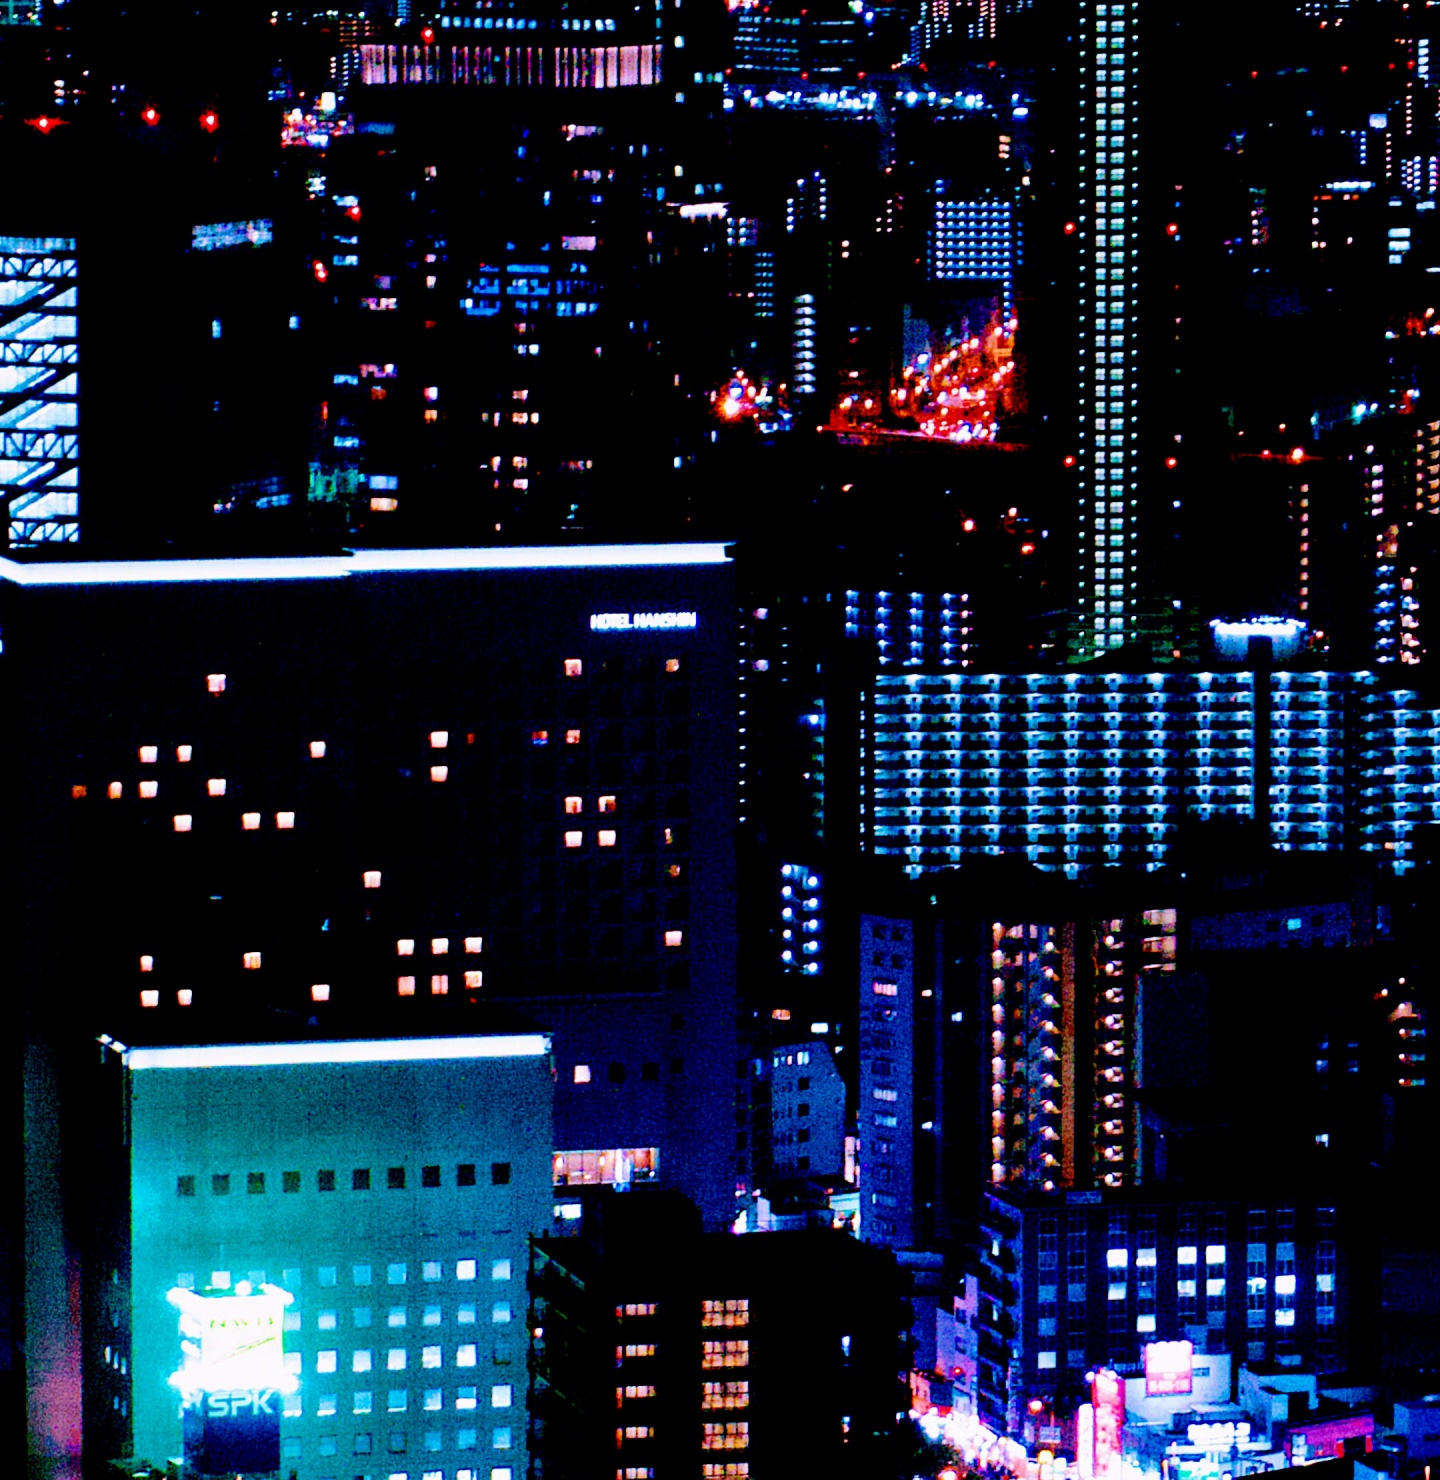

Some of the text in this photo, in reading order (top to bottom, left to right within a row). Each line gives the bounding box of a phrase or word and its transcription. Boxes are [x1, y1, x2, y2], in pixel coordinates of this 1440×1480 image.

[590, 612, 697, 629] HOTEL HANSHIN
[207, 1389, 274, 1418] SPK
